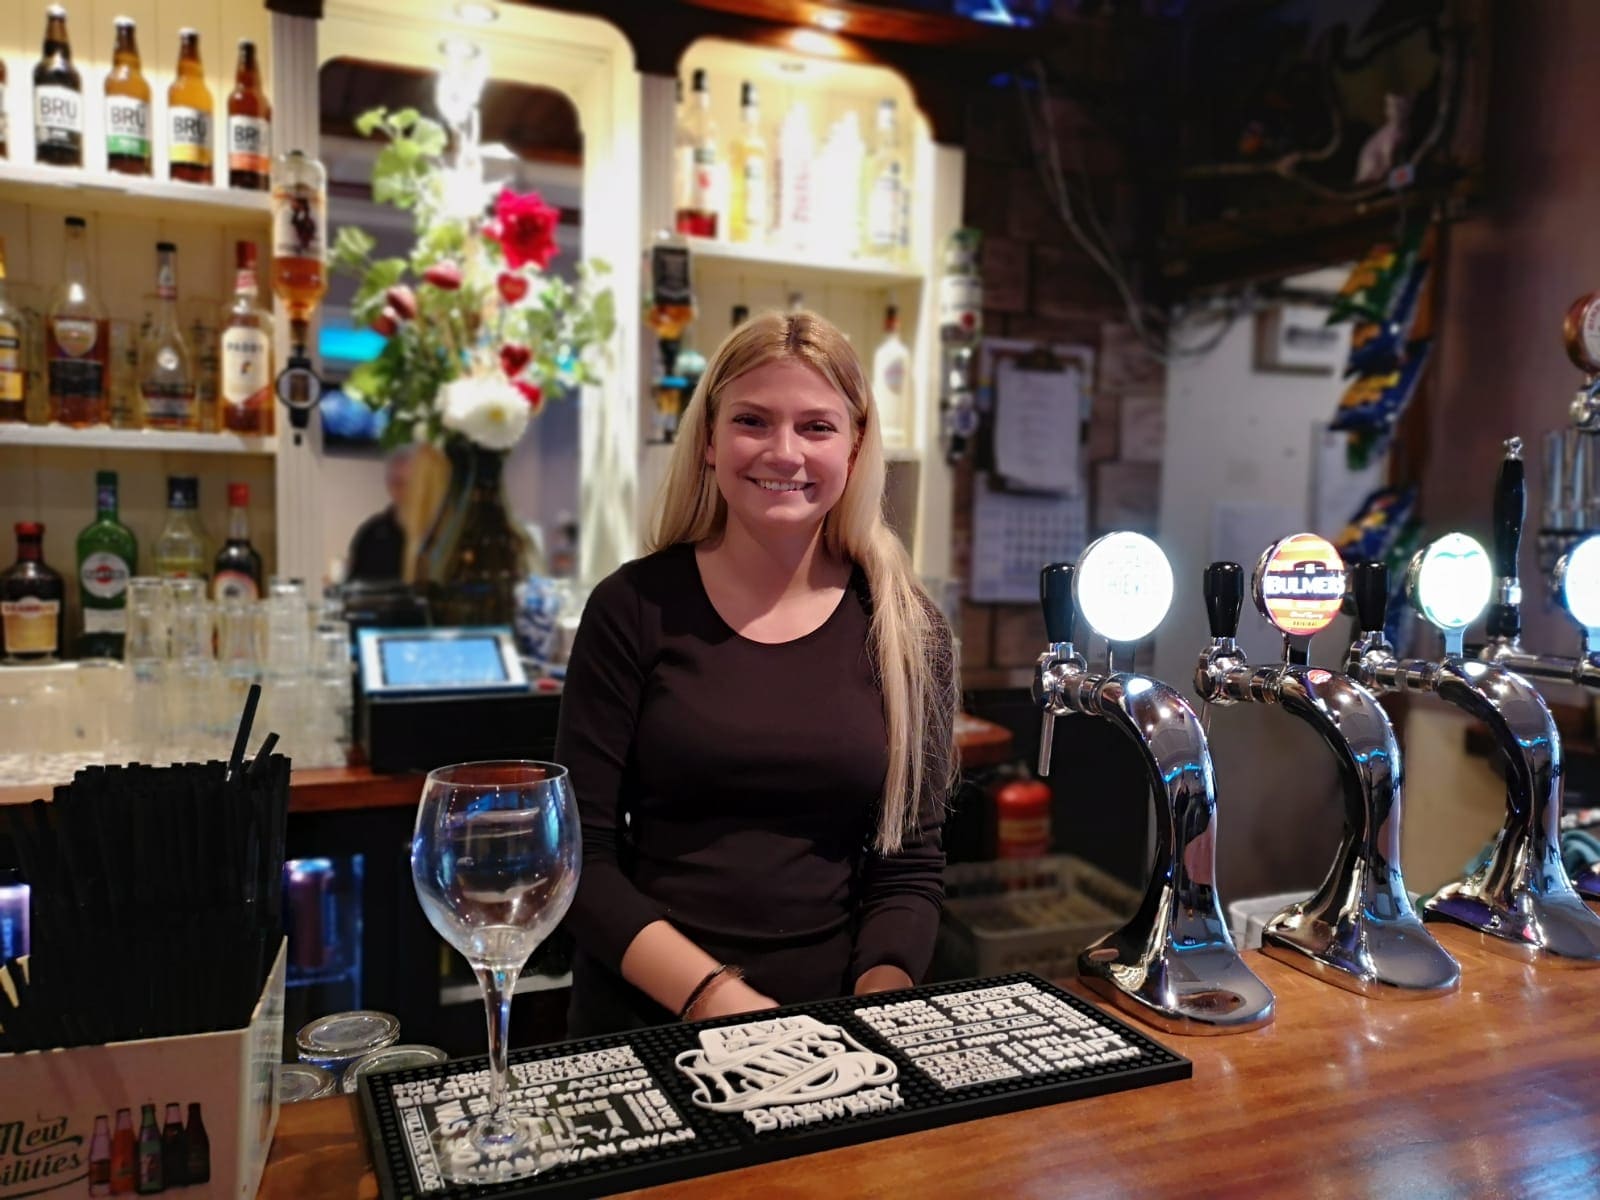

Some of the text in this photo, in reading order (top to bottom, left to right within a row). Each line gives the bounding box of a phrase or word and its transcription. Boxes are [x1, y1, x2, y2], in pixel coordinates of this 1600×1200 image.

[854, 1000, 927, 1016] GRAND
[951, 998, 1016, 1016] JUST
[992, 1006, 1028, 1018] ONE
[869, 1010, 947, 1031] IN THE
[961, 1032, 1009, 1047] MIND
[1009, 1024, 1061, 1039] THEM
[1022, 1026, 1115, 1049] WILL YE
[1038, 1034, 1127, 1060] SHIFT
[1053, 1056, 1085, 1070] ME
[393, 1077, 492, 1098] THE GOO
[555, 1077, 653, 1105] MAGGOT
[567, 1068, 649, 1091] ACTING
[396, 1086, 492, 1108] BISCUIT
[743, 1083, 905, 1134] BREWERY
[0, 1116, 70, 1156] New
[590, 1126, 631, 1141] YA
[621, 1128, 697, 1152] GWAN
[0, 1153, 82, 1186] ilities
